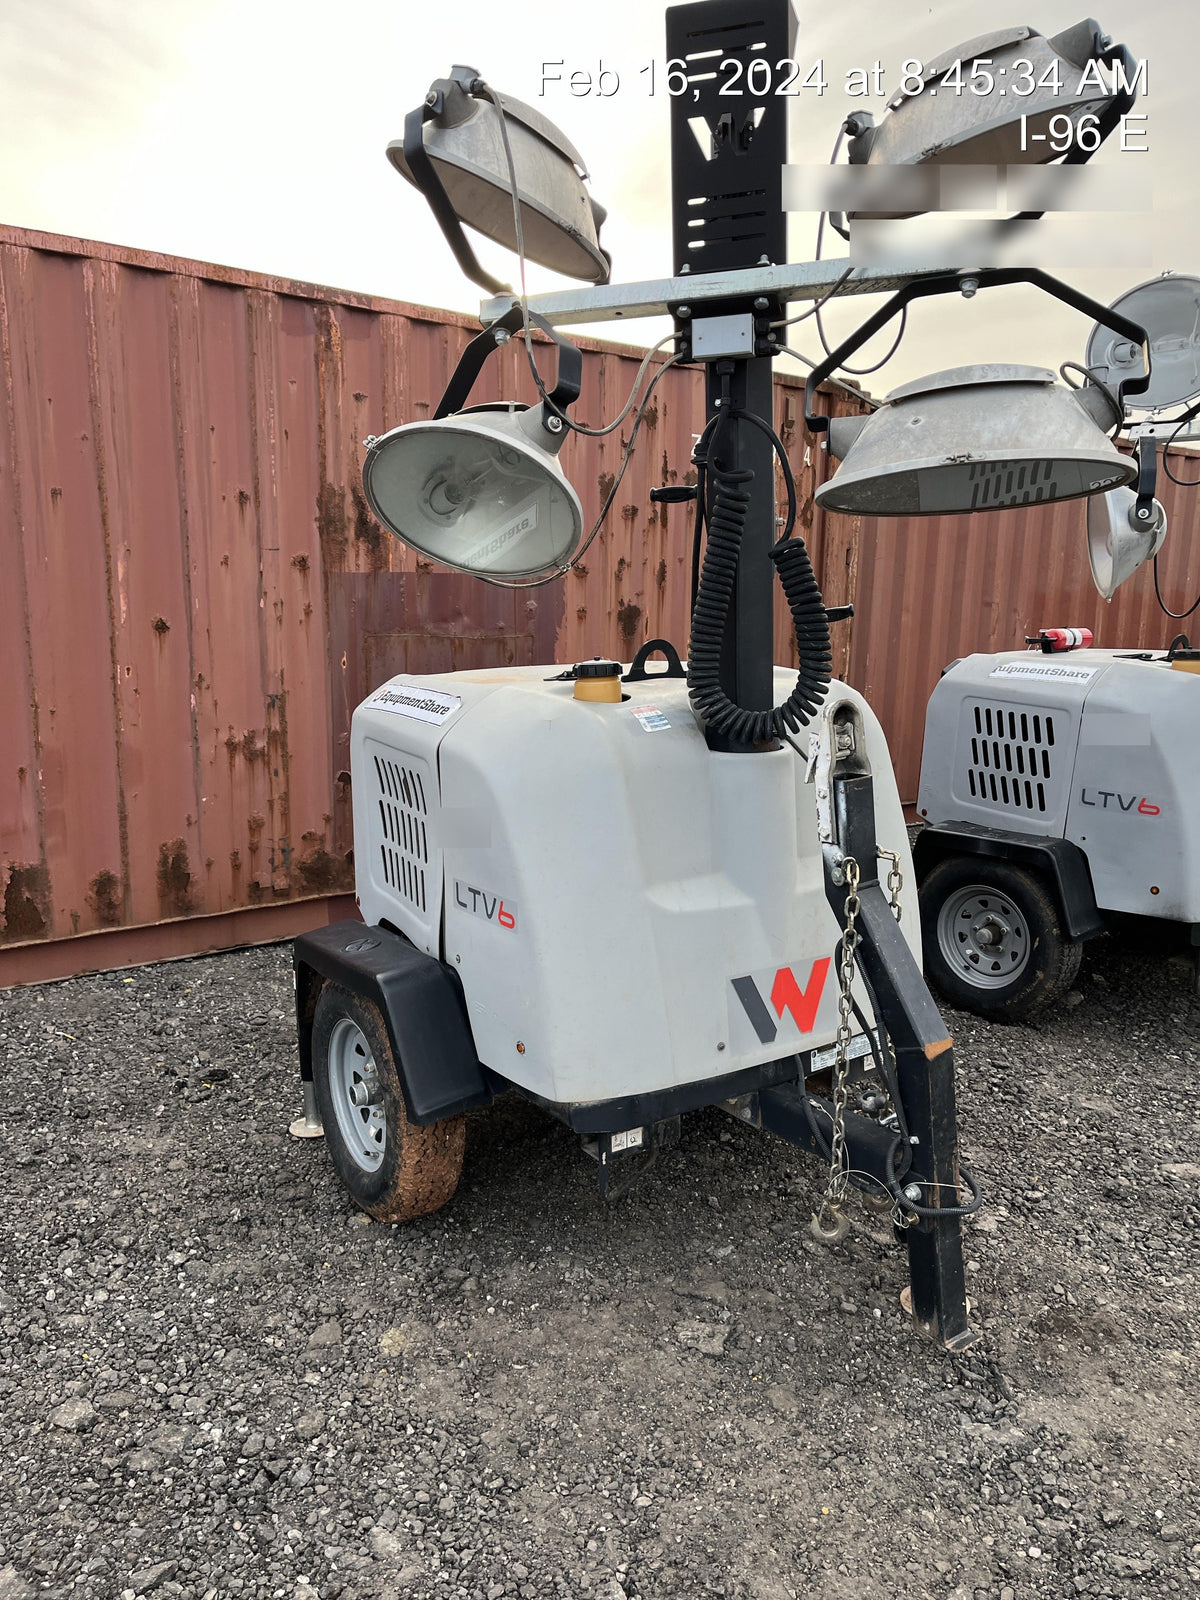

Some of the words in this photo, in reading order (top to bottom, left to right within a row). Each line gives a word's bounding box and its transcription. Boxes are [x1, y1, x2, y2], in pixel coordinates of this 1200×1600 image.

[380, 691, 450, 716] EquipmentShare
[1081, 788, 1161, 816] LTV6
[455, 881, 516, 929] LTV6
